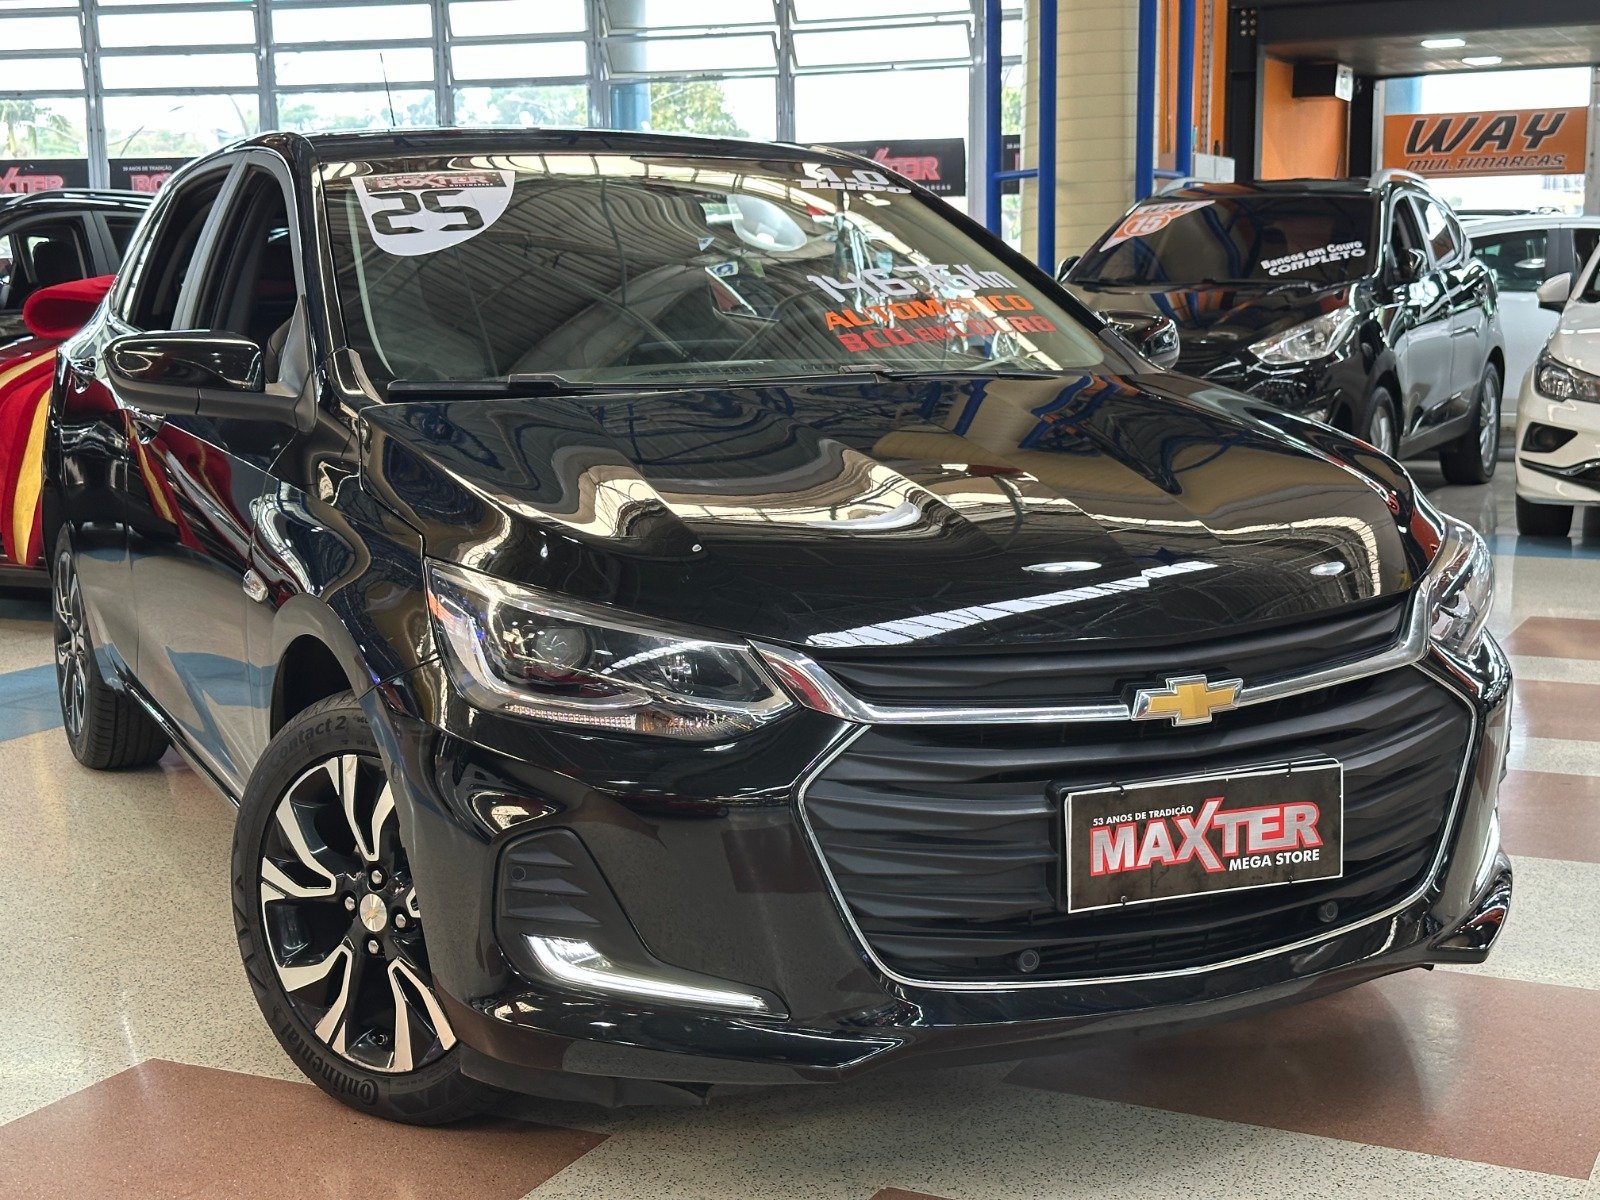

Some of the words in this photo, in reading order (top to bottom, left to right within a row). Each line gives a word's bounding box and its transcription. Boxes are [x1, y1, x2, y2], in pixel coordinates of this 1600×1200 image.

[1404, 111, 1568, 156] WAY
[1406, 153, 1567, 171] MULTIMARCAS
[369, 189, 485, 235] 25
[1130, 216, 1162, 233] 15
[1261, 252, 1306, 270] Bancos
[1307, 248, 1327, 258] em
[1327, 241, 1363, 253] Couro
[334, 715, 347, 731] 2
[1092, 817, 1104, 827] 53
[1106, 813, 1133, 825] ANOS
[1134, 811, 1147, 821] DE
[1148, 804, 1194, 819] TRADIÇÃO
[1089, 796, 1324, 877] MAXTER
[1228, 856, 1272, 872] MEGA
[1275, 848, 1320, 865] STORE
